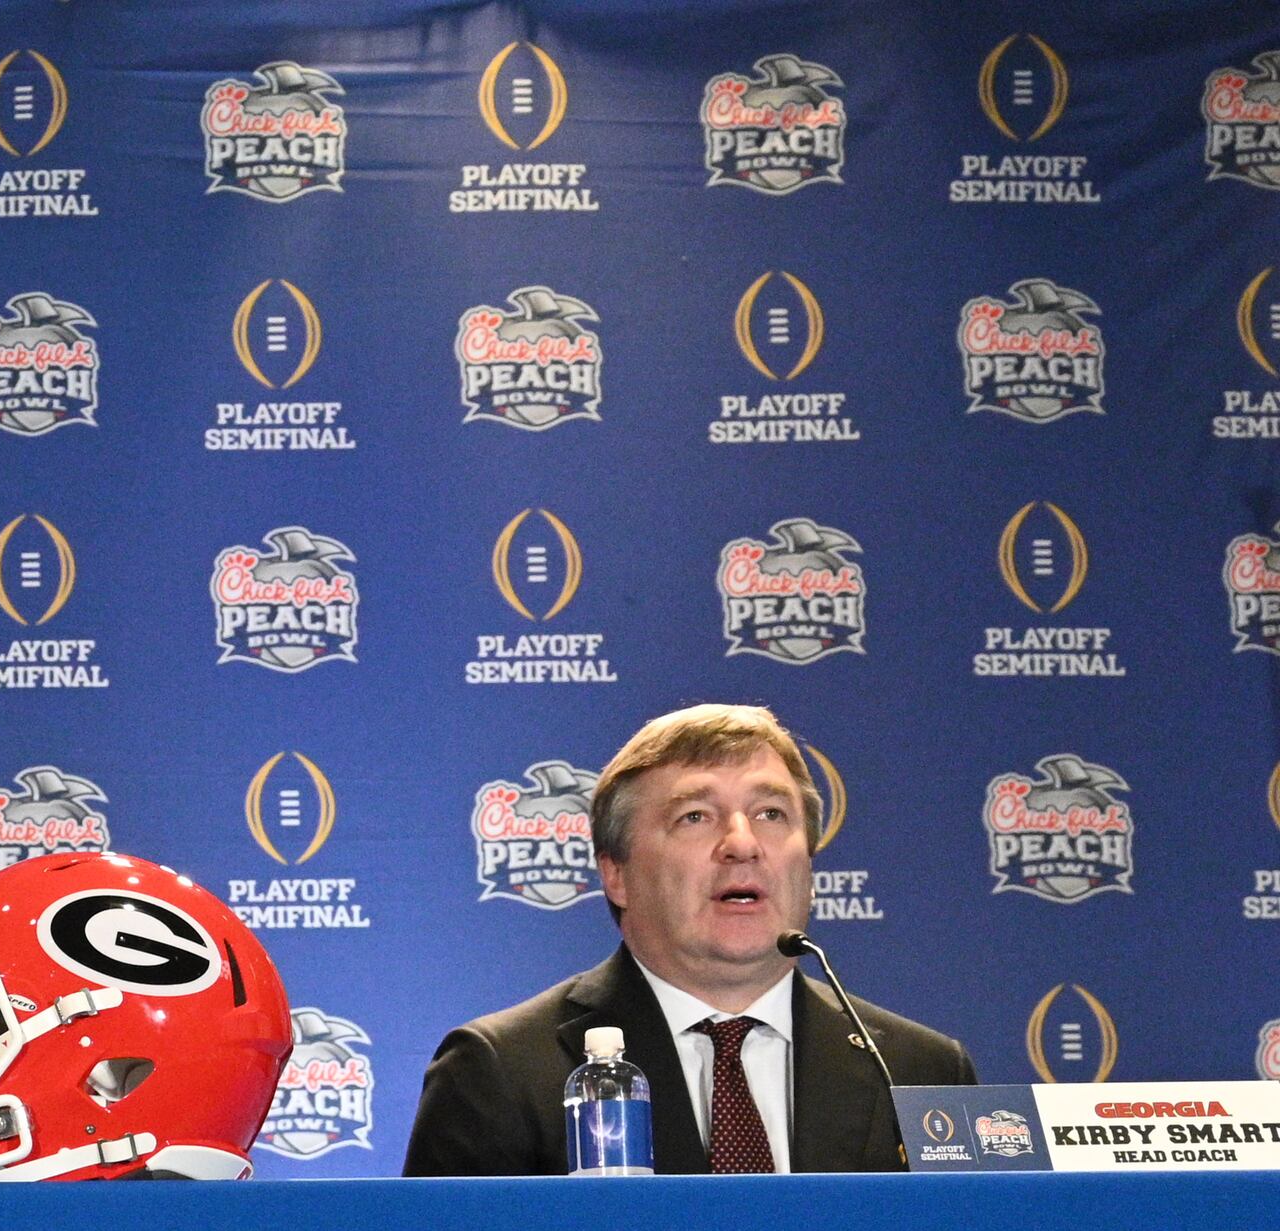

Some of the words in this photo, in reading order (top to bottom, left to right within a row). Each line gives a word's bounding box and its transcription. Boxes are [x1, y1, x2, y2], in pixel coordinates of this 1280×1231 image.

[211, 137, 339, 170] PEACH
[710, 129, 838, 163] PEACH
[237, 165, 313, 178] BOWL
[462, 162, 585, 187] PLAYOFF
[961, 155, 1087, 177] PLAYOFF
[450, 187, 598, 213] SEMIFINAL
[949, 180, 1100, 203] SEMIFINAL
[466, 364, 595, 398] PEACH
[969, 357, 1099, 389] PEACH
[493, 392, 570, 405] BOWL
[720, 392, 846, 418] PLAYOFF
[216, 401, 342, 426] PLAYOFF
[205, 426, 355, 452] SEMIFINAL
[709, 416, 860, 445] SEMIFINAL
[221, 606, 352, 639] PEACH
[728, 597, 859, 632] PEACH
[249, 634, 326, 647] BOWL
[756, 625, 834, 639] BOWL
[984, 627, 1111, 650] PLAYOFF
[477, 632, 603, 658] PLAYOFF
[466, 658, 617, 685] SEMIFINAL
[974, 652, 1125, 677] SEMIFINAL
[995, 836, 1127, 868] PEACH
[1023, 864, 1101, 876] BOWL
[229, 877, 356, 903] PLAYOFF
[230, 905, 370, 928] EMIFINAL
[50, 896, 211, 988] G
[1095, 1101, 1230, 1118] GEORGIA
[982, 1135, 1029, 1146] PEACH
[1051, 1125, 1163, 1145] KIRBY
[1168, 1122, 1280, 1144] SMART
[923, 1145, 965, 1153] PLAYOFF
[1114, 1150, 1167, 1163] HEAD
[1171, 1149, 1238, 1163] COACH
